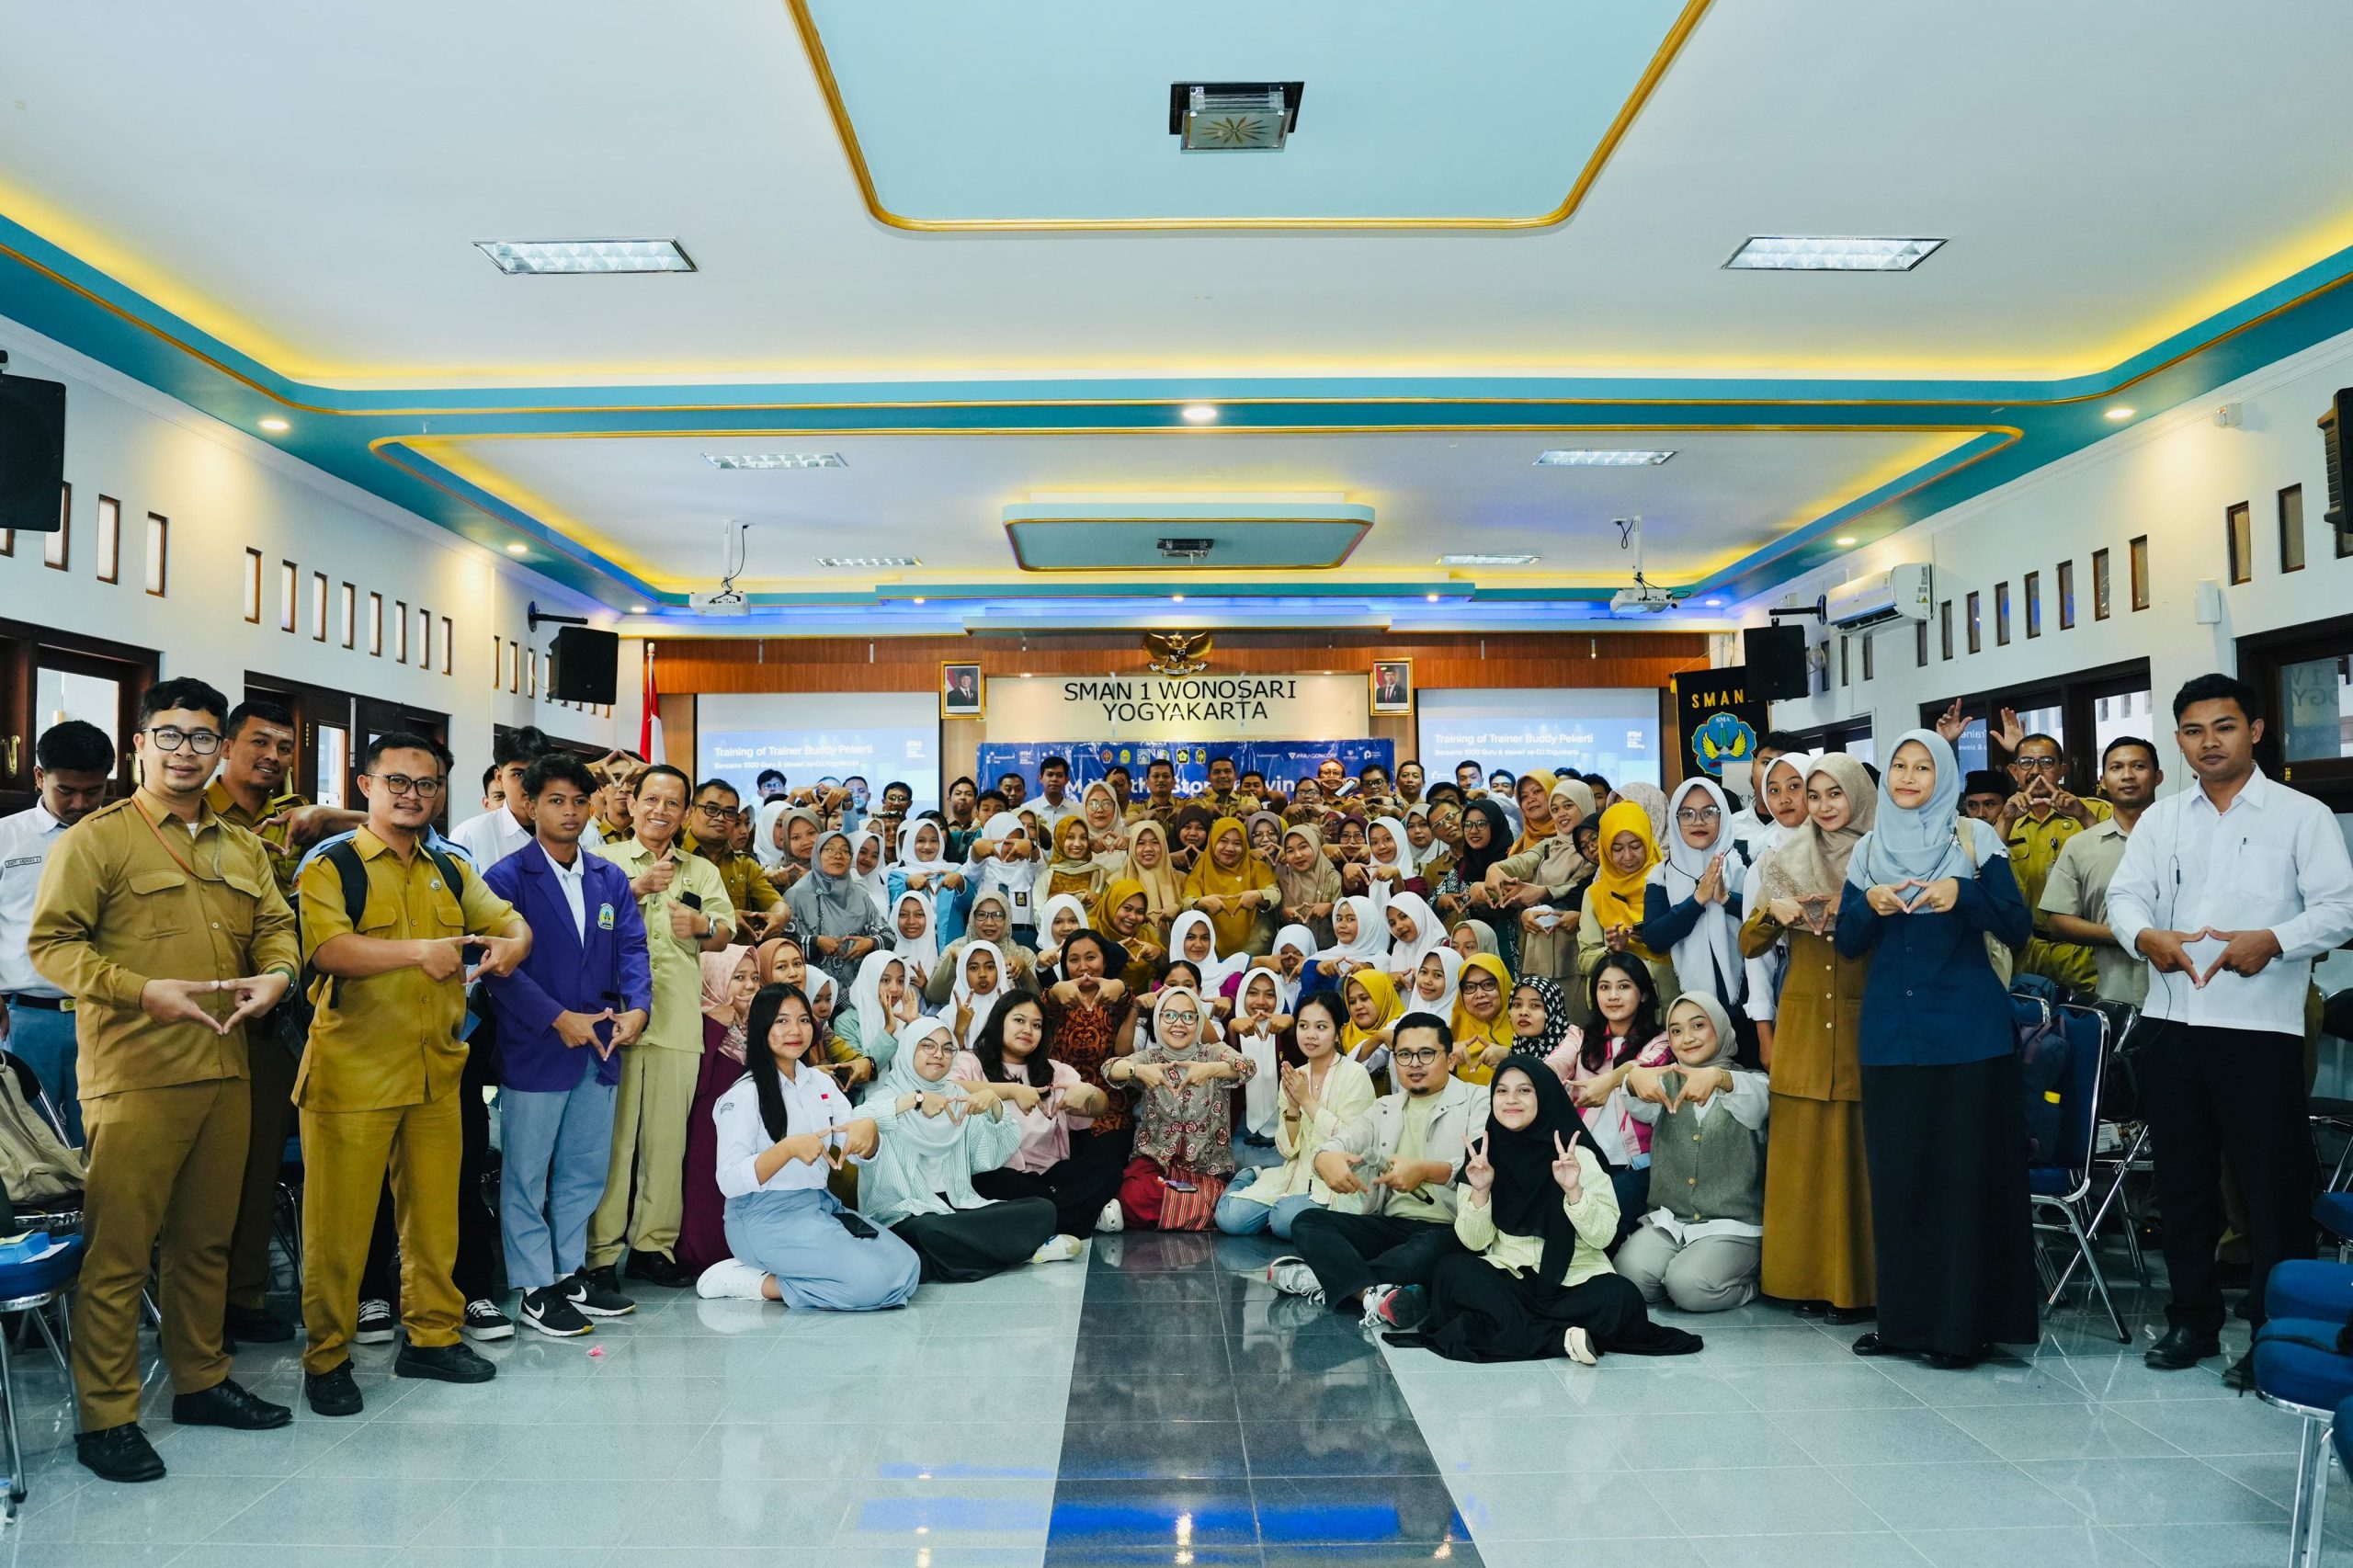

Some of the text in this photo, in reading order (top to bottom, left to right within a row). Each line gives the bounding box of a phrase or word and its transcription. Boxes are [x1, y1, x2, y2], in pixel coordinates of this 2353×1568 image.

[1064, 680, 1296, 700] SMAN 1 WONOSARI
[1691, 688, 1745, 709] SMAN
[1103, 700, 1268, 722] YOGYAKARTA
[1435, 733, 1593, 744] Training of Trainer Buddy Pekerti
[714, 744, 873, 757] Training of Trainer Buddy Pekerti
